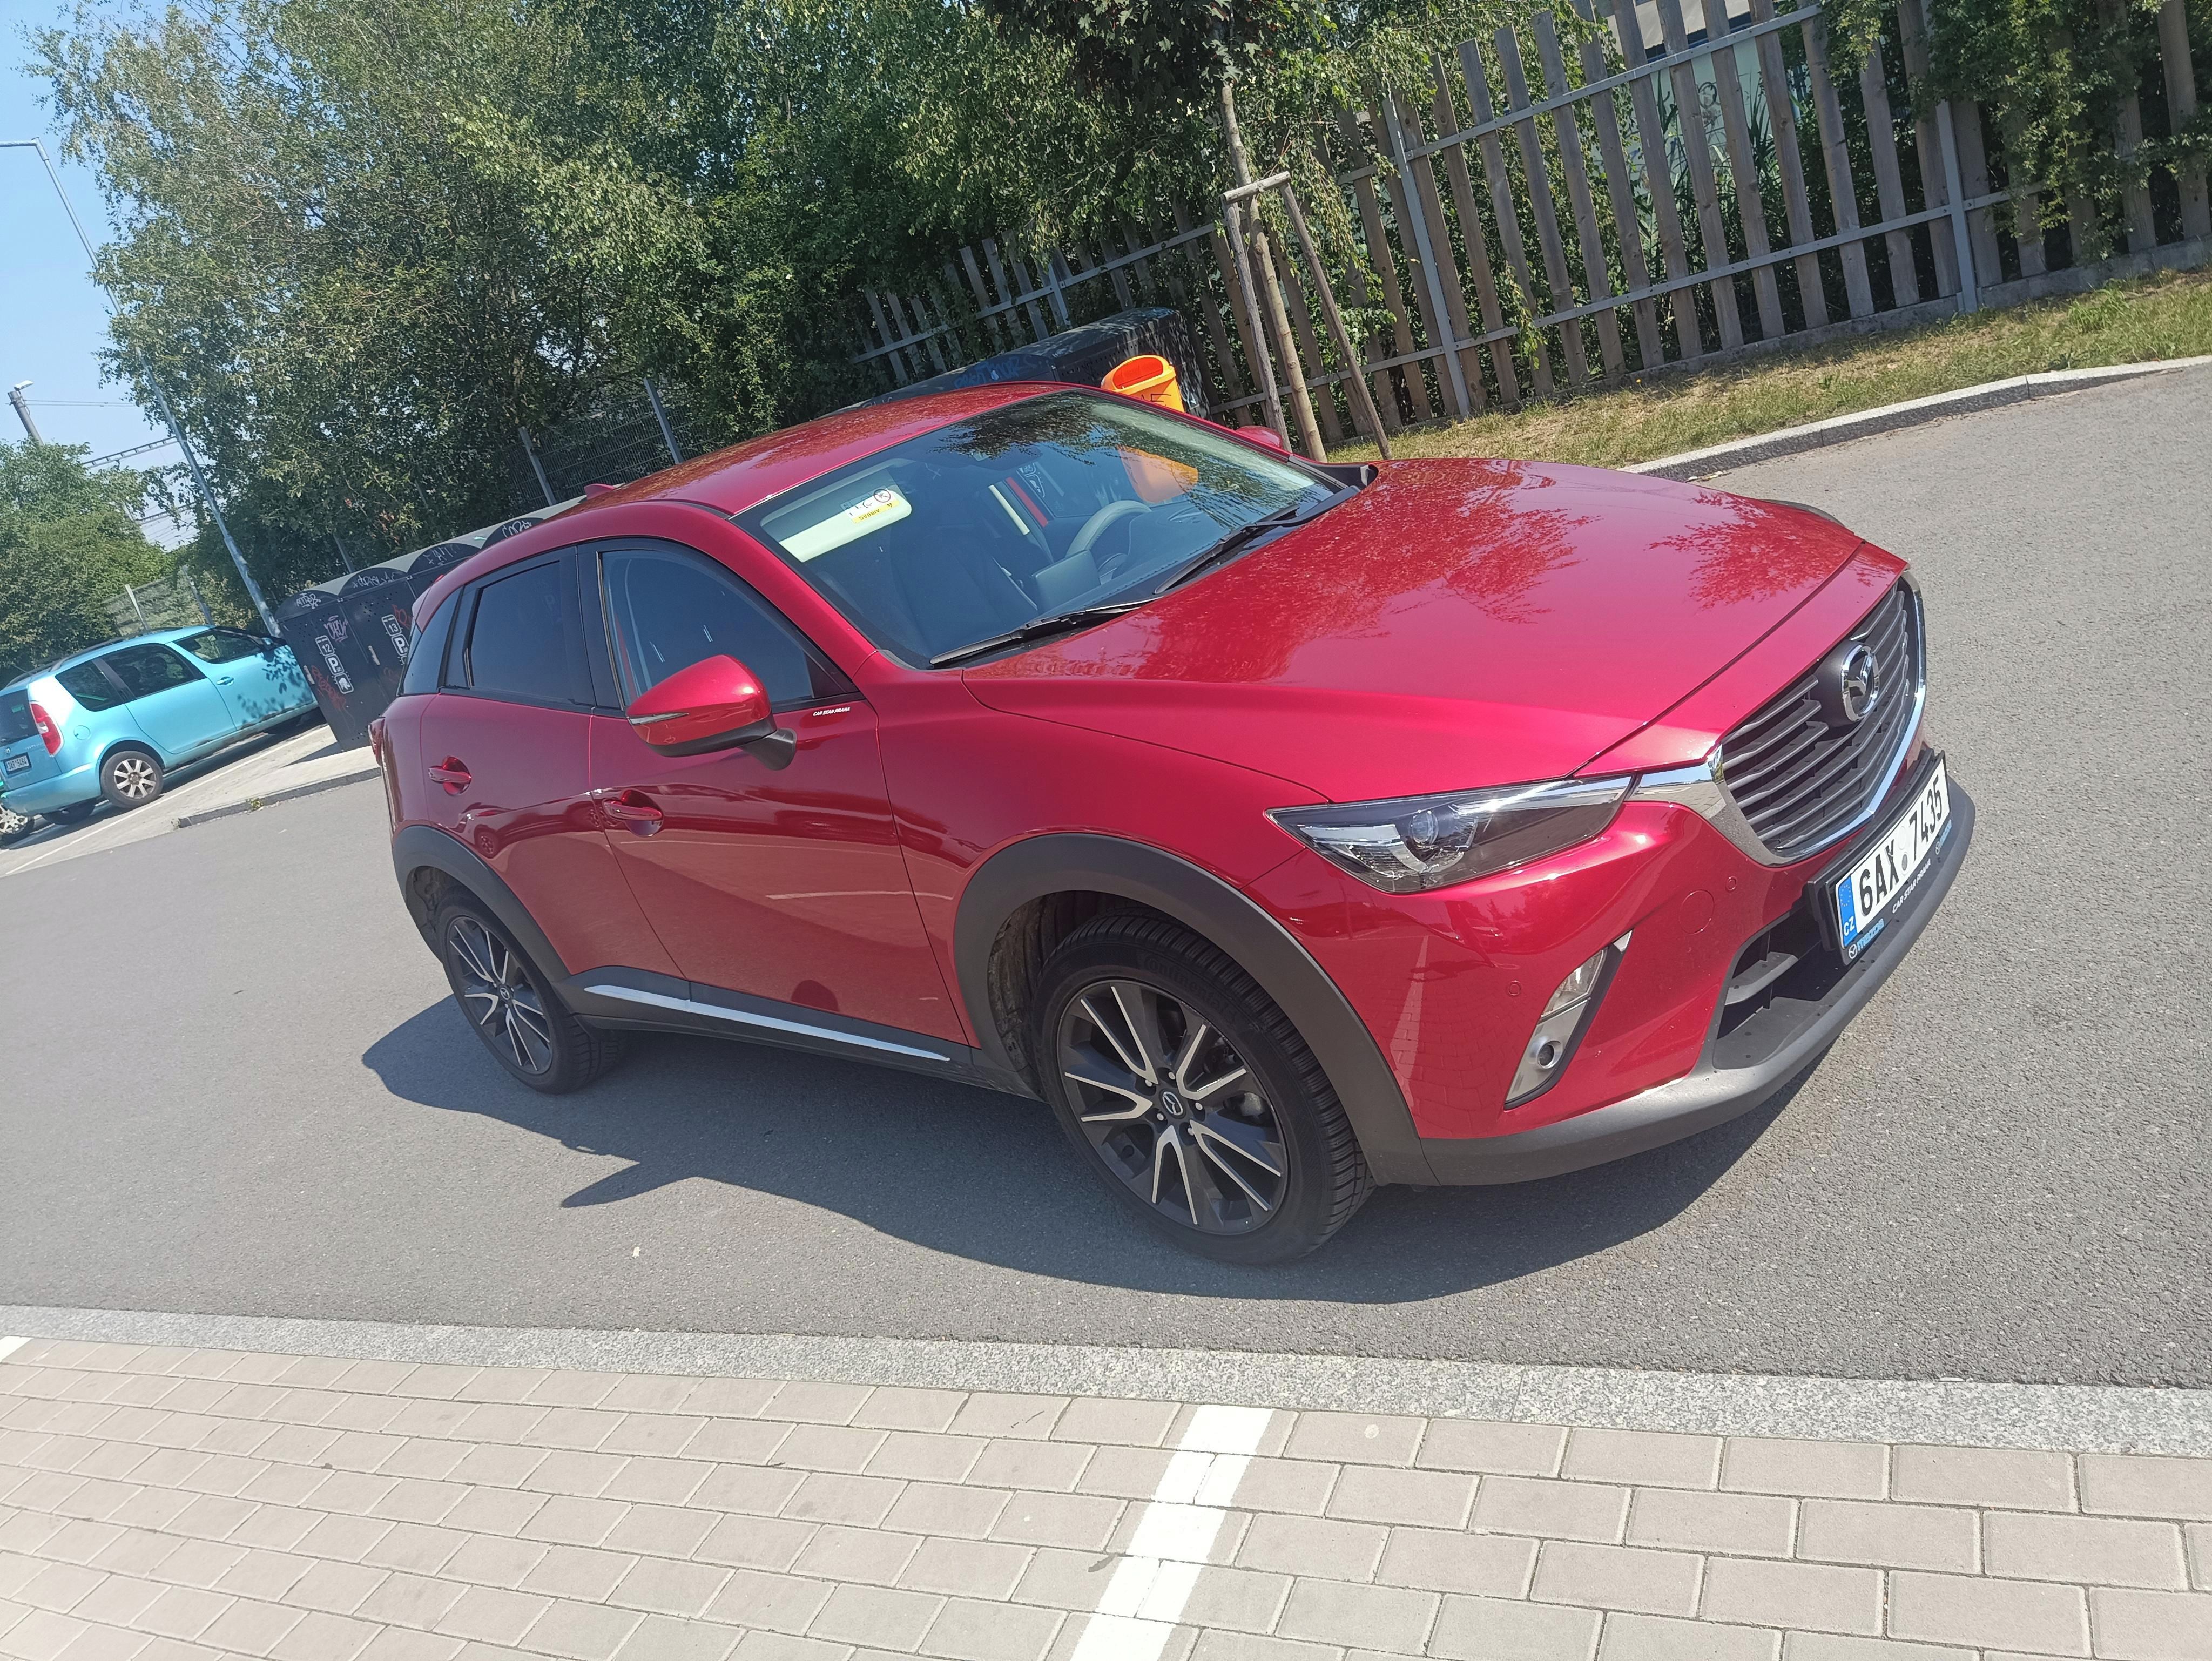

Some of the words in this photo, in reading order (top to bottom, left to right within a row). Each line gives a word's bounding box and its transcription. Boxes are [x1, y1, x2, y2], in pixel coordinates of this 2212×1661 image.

[859, 509, 880, 521] AIRBAG
[388, 623, 399, 633] 13
[322, 643, 332, 653] 12
[394, 637, 406, 653] P
[328, 657, 339, 673] P
[1859, 839, 1899, 916] 6AX
[1909, 774, 1943, 864] 7435
[1892, 895, 1904, 914] CAR
[1904, 879, 1917, 900] STAR
[1916, 857, 1931, 884] PRAHA
[1843, 915, 1855, 936] CZ
